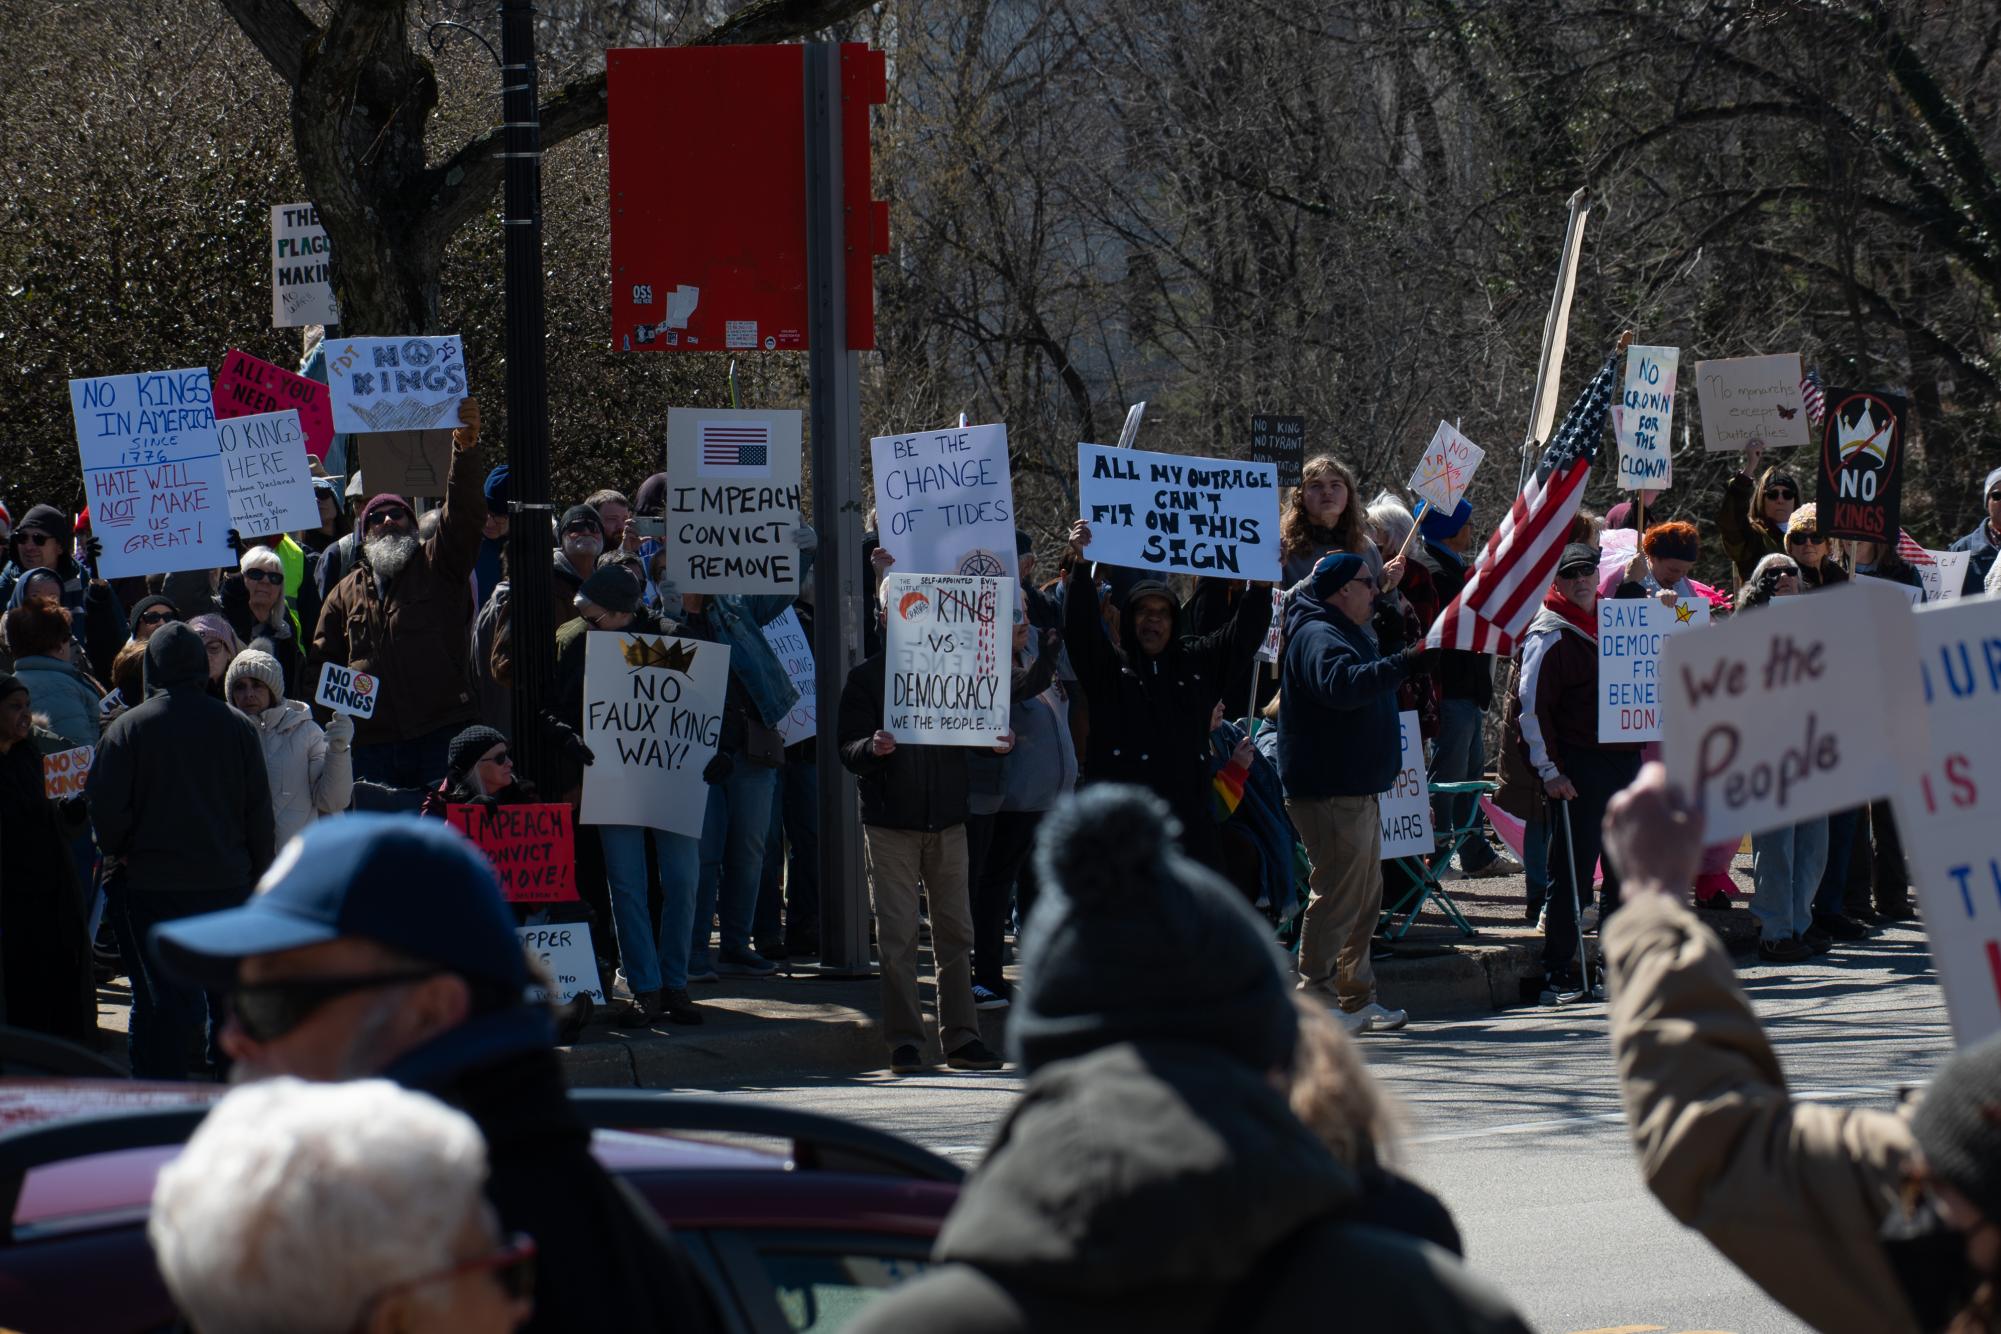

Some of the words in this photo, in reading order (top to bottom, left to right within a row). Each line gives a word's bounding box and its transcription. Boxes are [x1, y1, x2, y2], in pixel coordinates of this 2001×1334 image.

[283, 208, 319, 227] THE
[232, 359, 263, 384] ALL
[281, 377, 316, 403] YOU
[352, 363, 465, 396] KINGS
[1640, 357, 1659, 385] NO
[83, 382, 115, 408] NO
[136, 374, 211, 407] KINGS
[1704, 375, 1733, 399] No
[1737, 383, 1796, 397] monarchs
[1625, 390, 1670, 414] CROWN
[96, 413, 131, 437] IN
[140, 406, 216, 435] AMERICA
[242, 418, 301, 449] KINGS
[1253, 419, 1268, 433] NO
[1640, 414, 1660, 432] FOR
[1715, 427, 1788, 442] butterflies
[132, 436, 178, 451] SINCE
[894, 438, 919, 459] BE
[935, 433, 972, 455] THE
[1254, 434, 1267, 448] NO
[1269, 435, 1303, 450] TYRANT
[1449, 439, 1469, 460] NO
[1635, 431, 1657, 451] THE
[122, 449, 168, 464] 1776
[227, 451, 287, 481] HERE
[95, 469, 140, 497] HATE
[144, 463, 206, 489] WILL
[257, 477, 296, 490] Declared
[886, 459, 998, 500] CHANGE
[1092, 455, 1140, 480] ALL
[1150, 463, 1183, 484] MY
[1187, 468, 1272, 490] OUTRAGE
[1840, 469, 1877, 502] NO
[100, 497, 141, 522] NOT
[150, 488, 210, 514] MAKE
[241, 493, 272, 511] 1776
[269, 507, 288, 516] Won
[672, 484, 801, 515] IMPEACH
[1154, 490, 1222, 514] CAN'T
[149, 517, 169, 530] US
[248, 516, 279, 535] 1787
[891, 509, 924, 535] OF
[938, 500, 1009, 527] TIDES
[1092, 503, 1135, 527] FIT
[1145, 510, 1179, 535] ON
[1189, 514, 1261, 545] THIS
[1833, 503, 1886, 533] KINGS
[124, 521, 203, 554] GREAT!
[679, 522, 790, 547] CONVICT
[1141, 535, 1241, 574] SIGN
[688, 555, 793, 583] REMOVE
[920, 577, 974, 586] SELF-APPOINTED
[980, 577, 996, 586] EVIL
[936, 589, 995, 622] KING
[1603, 606, 1648, 628] SAVE
[327, 667, 350, 687] NO
[1680, 658, 1747, 708] We
[1763, 637, 1827, 690] the
[323, 682, 373, 712] KINGS
[634, 674, 681, 703] NO
[894, 672, 999, 711] DEMOCRACY
[589, 701, 660, 734] FAUX
[670, 706, 721, 748] KING
[891, 715, 910, 730] WE
[913, 715, 934, 730] THE
[44, 753, 70, 775] NO
[616, 738, 690, 771] WAY!
[1695, 714, 1840, 811] People
[458, 808, 564, 841] IMPEACH
[1380, 814, 1423, 842] WARS
